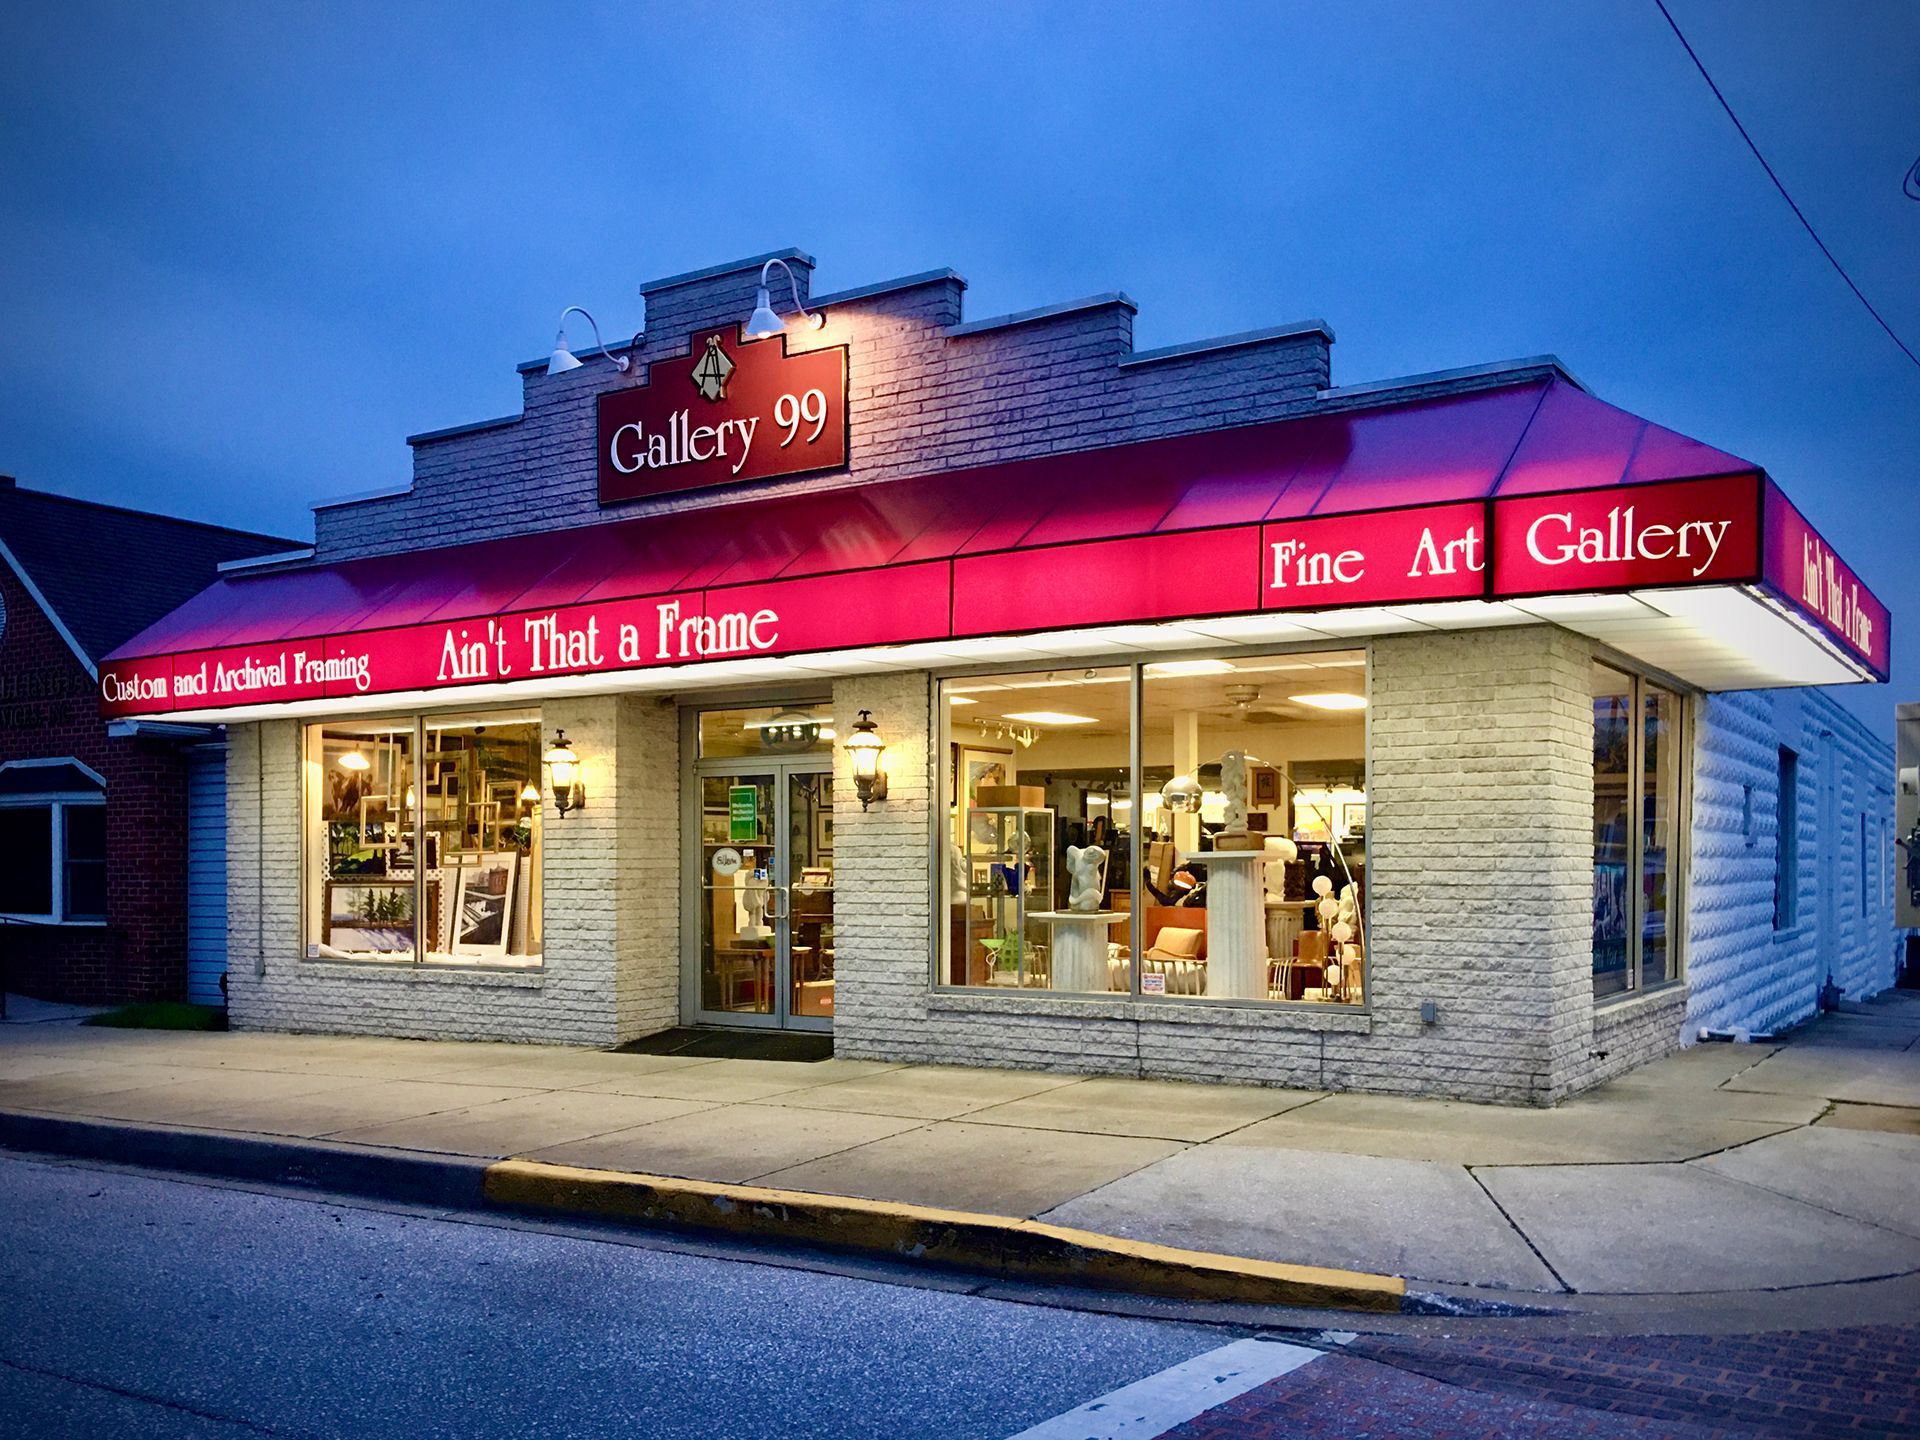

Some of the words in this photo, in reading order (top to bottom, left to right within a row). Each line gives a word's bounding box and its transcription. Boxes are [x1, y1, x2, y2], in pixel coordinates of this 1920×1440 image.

[610, 408, 760, 474] Gallery
[774, 388, 827, 448] 99
[1270, 538, 1365, 589] Fine
[1407, 526, 1486, 577] Art
[1526, 505, 1732, 577] Gallery
[1802, 532, 1825, 616] Ain't
[1825, 551, 1844, 632] That
[1845, 594, 1851, 639] a
[1851, 583, 1873, 657] Frame
[102, 671, 168, 702] Custom
[173, 662, 208, 697] and
[213, 652, 287, 693] Archival
[294, 649, 371, 693] Framing
[436, 620, 512, 681] Ain't
[524, 614, 604, 672] That
[618, 623, 641, 663] a
[655, 600, 779, 659] Frame
